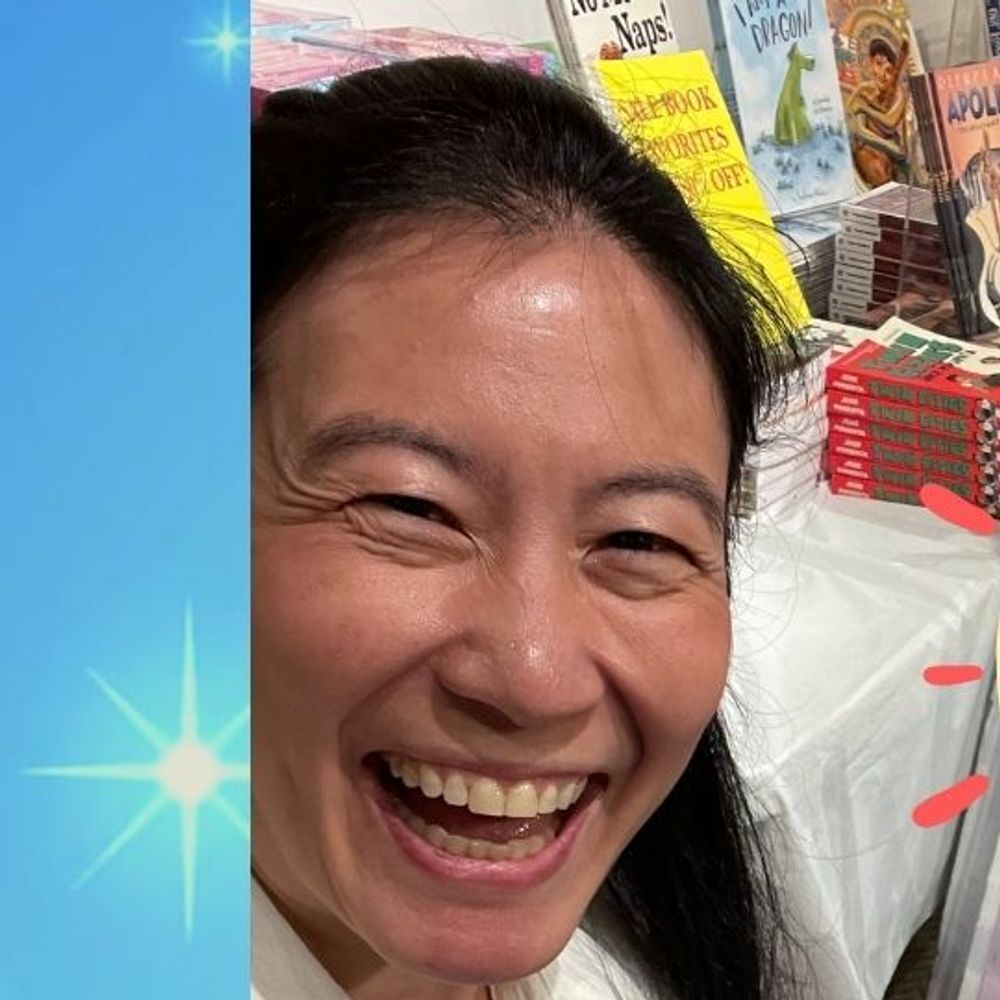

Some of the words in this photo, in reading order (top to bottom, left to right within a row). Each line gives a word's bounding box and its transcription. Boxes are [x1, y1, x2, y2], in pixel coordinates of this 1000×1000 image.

[611, 2, 674, 55] Naps!
[750, 0, 813, 54] DRAGON!
[661, 85, 718, 117] BOOK
[709, 162, 751, 192] OFF!
